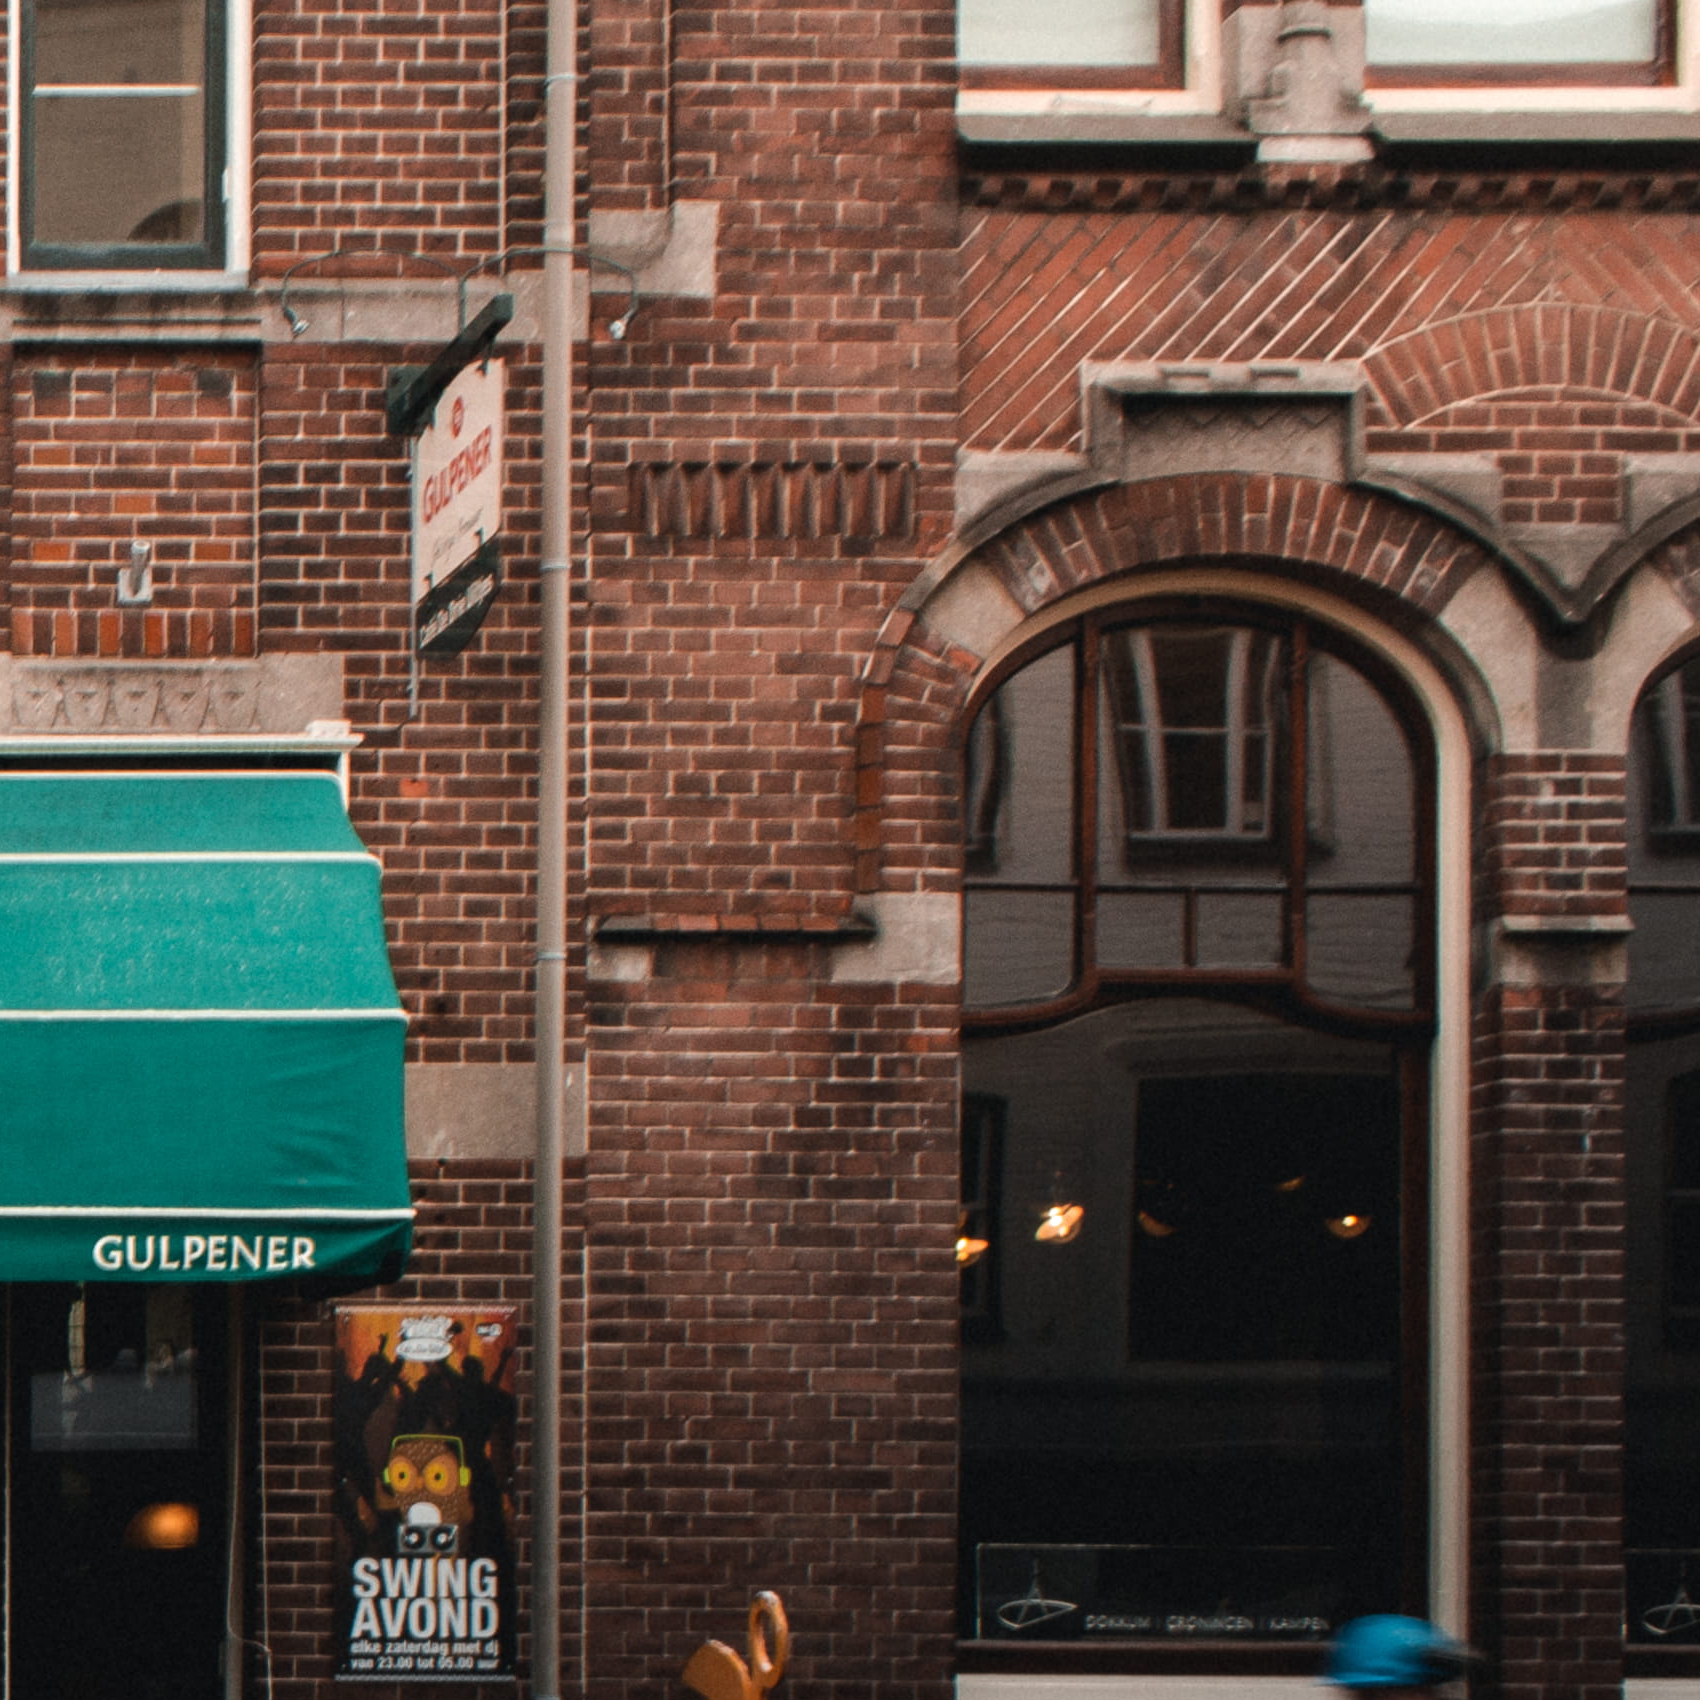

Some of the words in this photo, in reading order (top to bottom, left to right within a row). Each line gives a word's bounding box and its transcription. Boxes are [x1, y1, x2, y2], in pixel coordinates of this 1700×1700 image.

[423, 424, 492, 524] GULPENER
[92, 1235, 316, 1271] GULPENER
[353, 1558, 498, 1598] SWING
[351, 1598, 499, 1638] AVOND
[350, 1640, 382, 1654] elke
[385, 1640, 451, 1657] zaterdag
[453, 1641, 482, 1654] met
[485, 1640, 500, 1657] dj
[350, 1658, 374, 1669] van
[417, 1656, 435, 1669] tot
